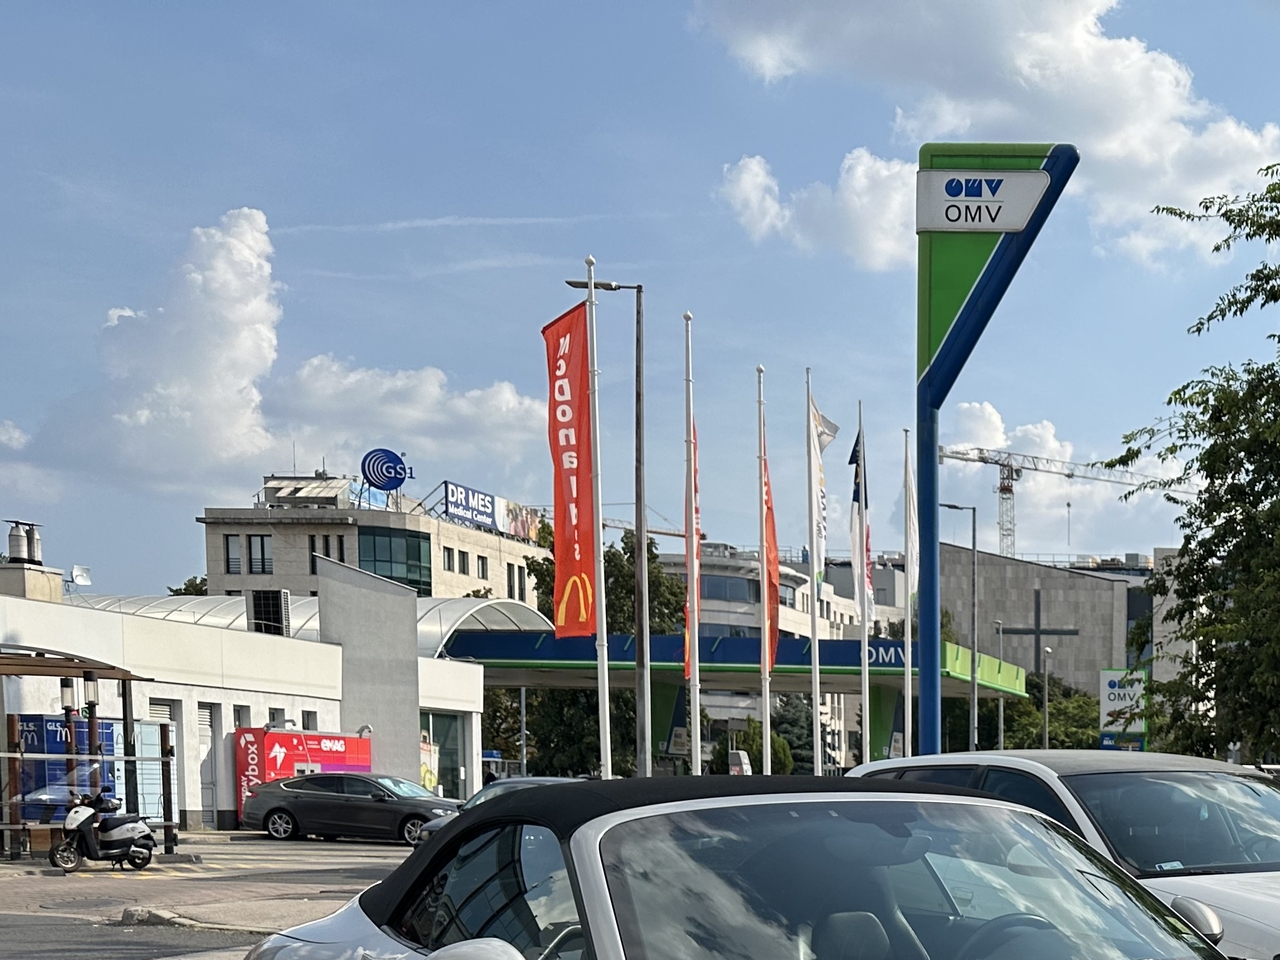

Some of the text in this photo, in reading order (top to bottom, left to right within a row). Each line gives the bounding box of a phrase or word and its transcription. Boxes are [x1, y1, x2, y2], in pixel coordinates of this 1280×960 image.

[945, 204, 1002, 223] OMV
[382, 464, 416, 480] GS1
[448, 484, 493, 514] DR MES
[448, 502, 493, 526] Medical Center
[1108, 692, 1136, 702] OMV
